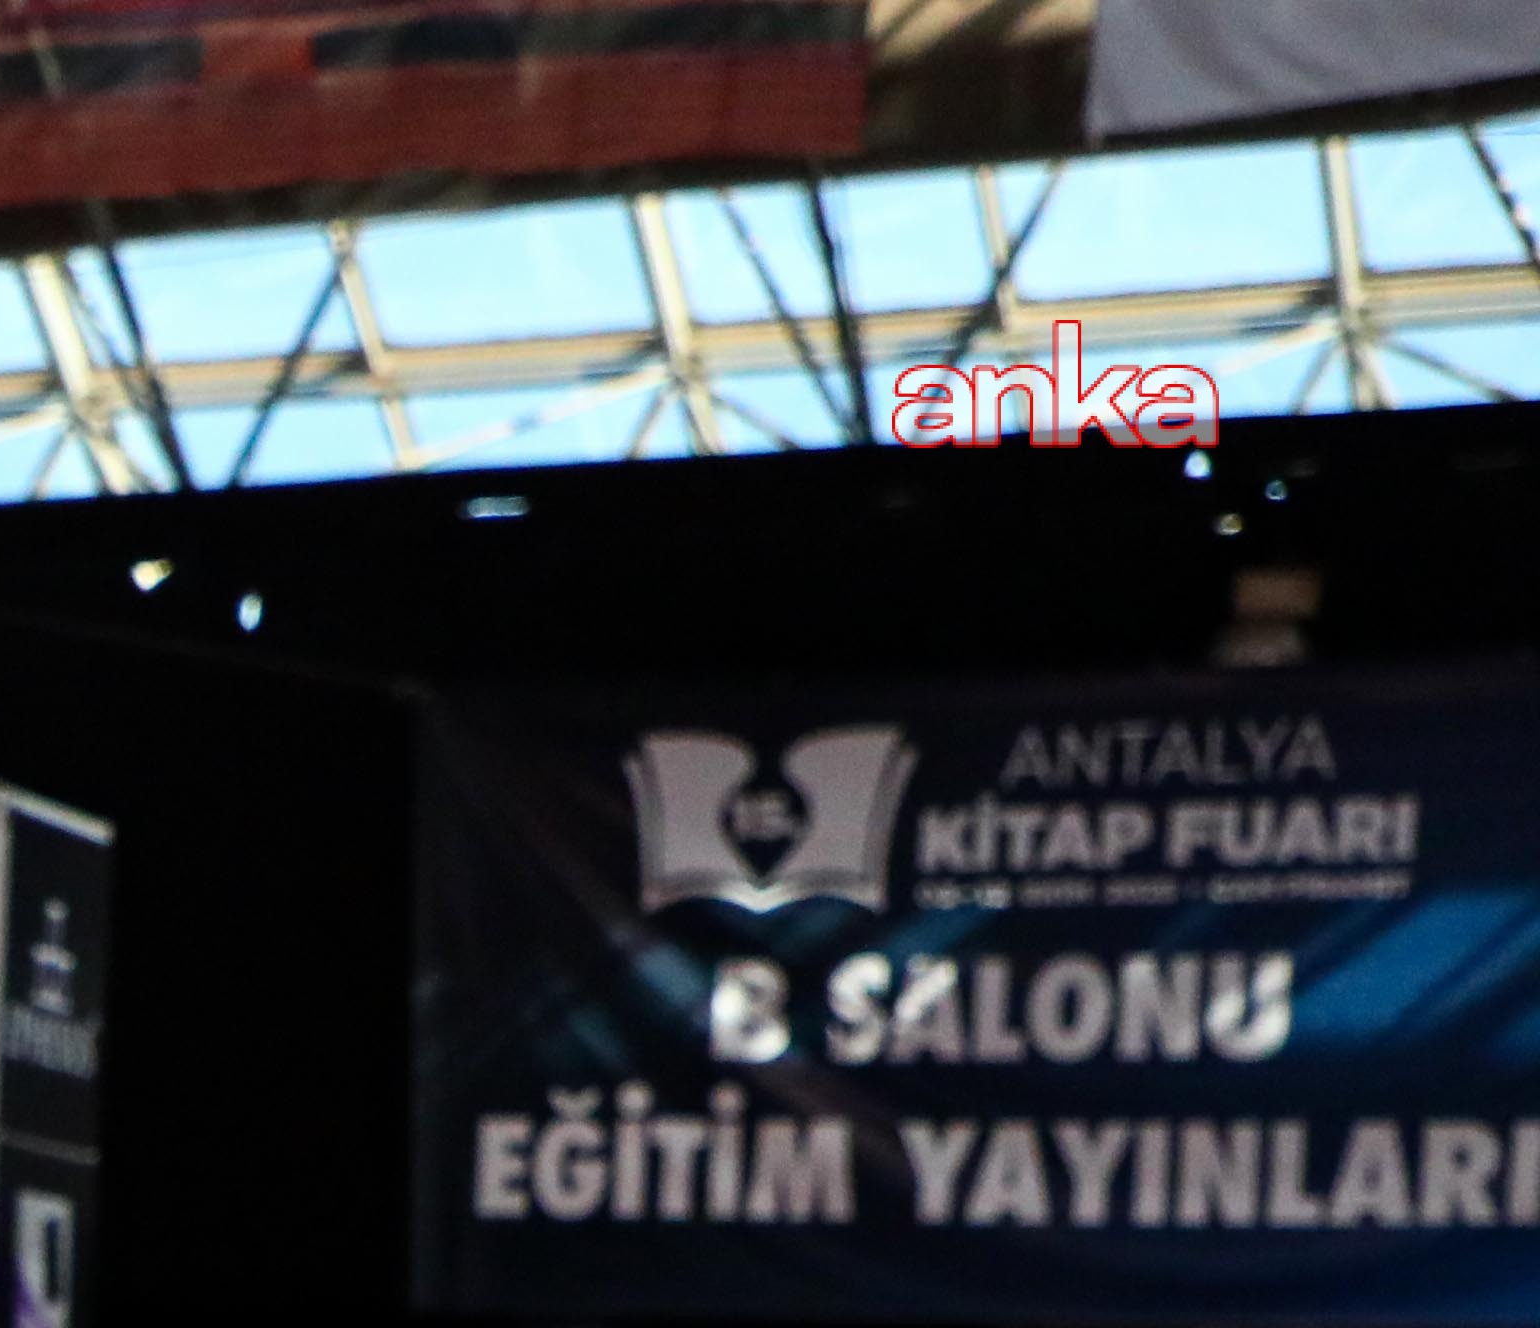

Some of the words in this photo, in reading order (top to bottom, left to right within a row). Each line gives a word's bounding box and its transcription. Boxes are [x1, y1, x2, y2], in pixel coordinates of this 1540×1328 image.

[1000, 714, 1338, 789] ANTALYA
[917, 793, 1151, 873] KİTAP
[1165, 793, 1418, 867] FUARI
[713, 957, 790, 1062] B
[828, 953, 1291, 1060] SALONU
[474, 1081, 852, 1222] EĞİTİM
[903, 1115, 1540, 1227] YAYINLARI
